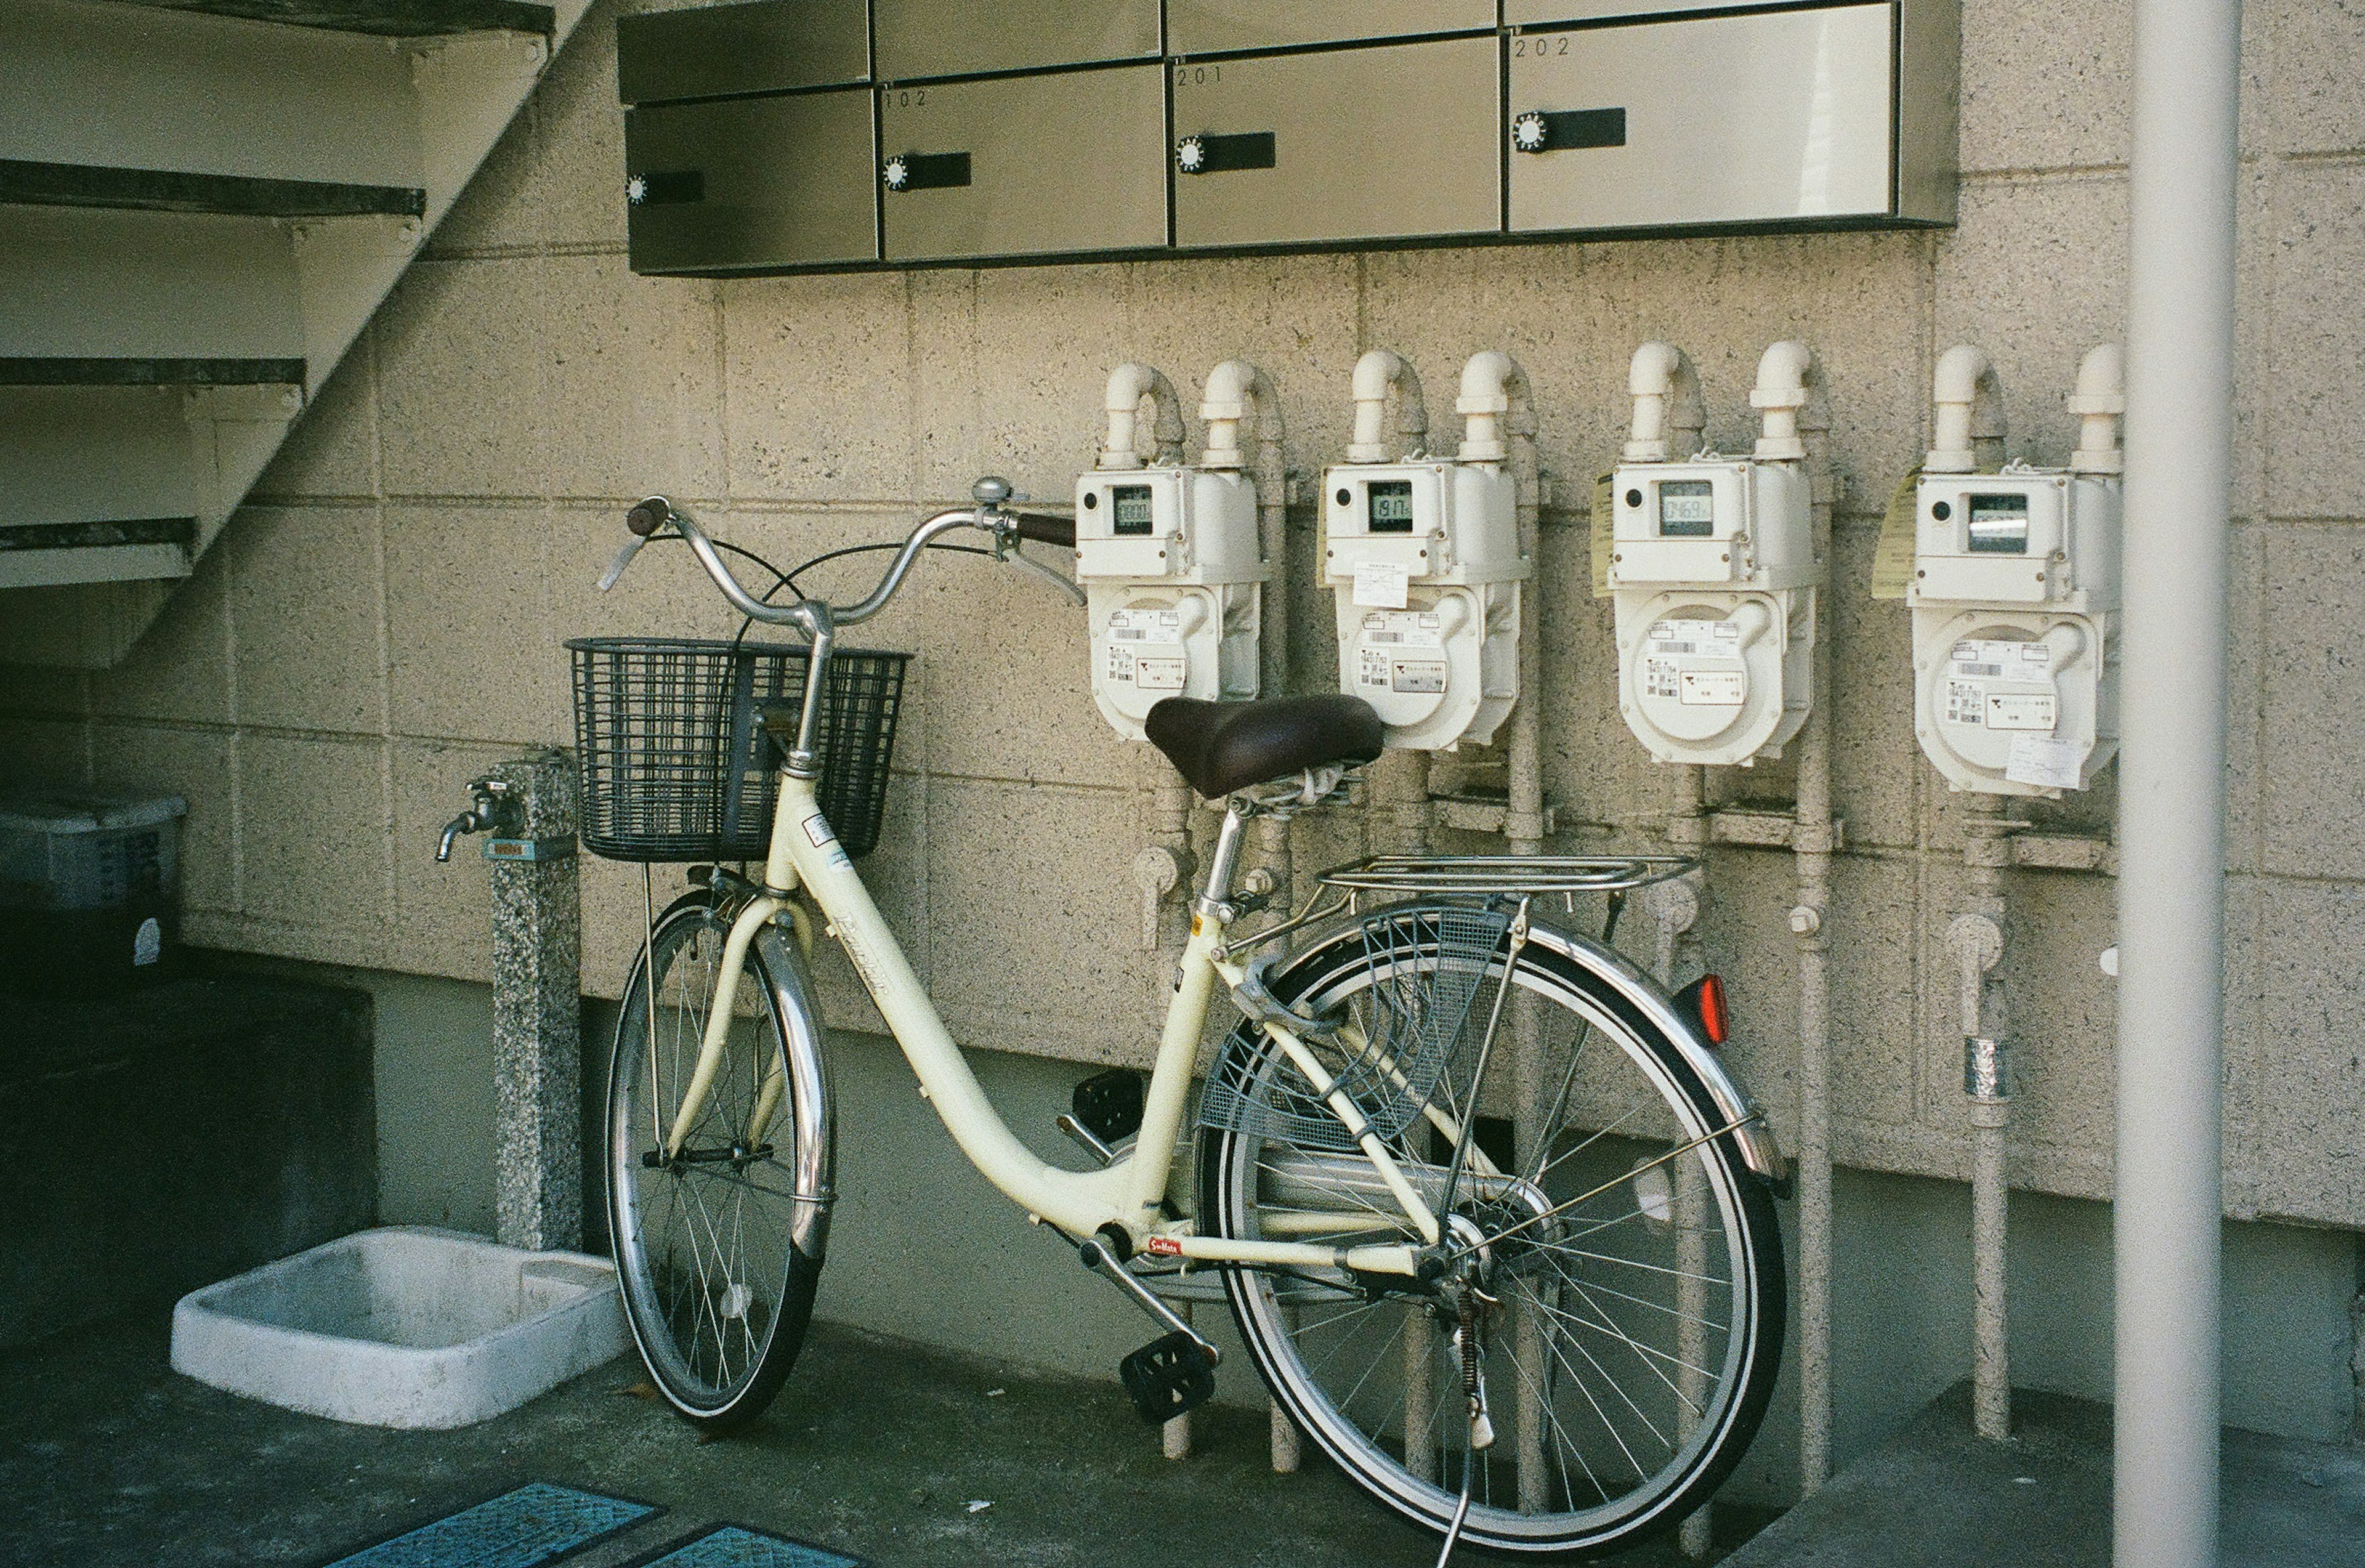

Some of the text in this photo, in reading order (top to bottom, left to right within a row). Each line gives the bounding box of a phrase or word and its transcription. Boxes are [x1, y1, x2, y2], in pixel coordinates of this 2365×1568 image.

[1515, 38, 1569, 57] 202
[1178, 65, 1220, 86] 201
[886, 90, 925, 108] 102
